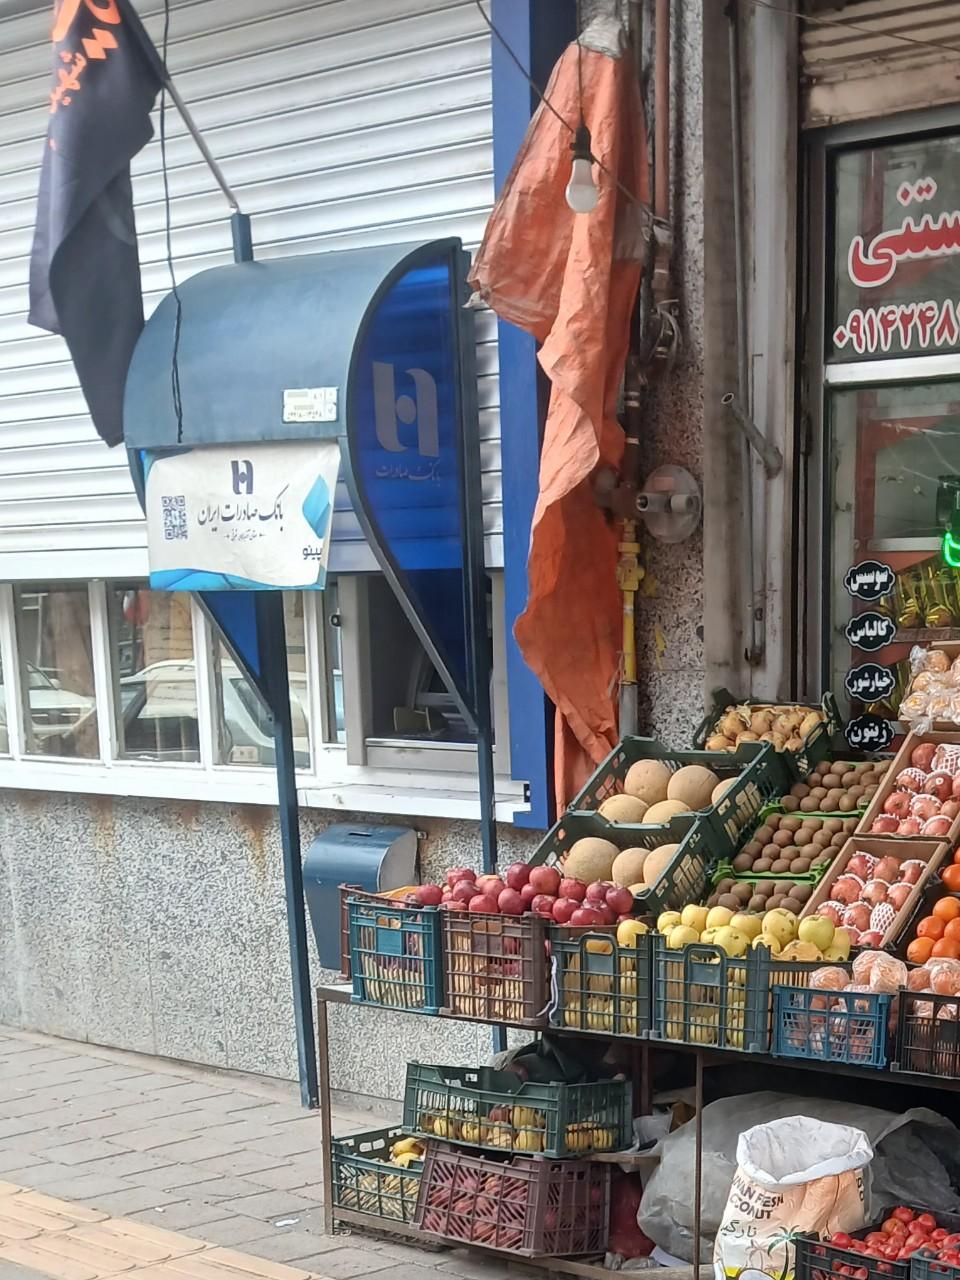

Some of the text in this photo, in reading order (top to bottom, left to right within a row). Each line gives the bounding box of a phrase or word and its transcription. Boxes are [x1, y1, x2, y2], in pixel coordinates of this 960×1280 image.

[197, 483, 289, 532] بانک صادرات ایران
[850, 569, 889, 592] سوسیس
[850, 620, 889, 643] کالباس
[850, 721, 889, 744] زیتون
